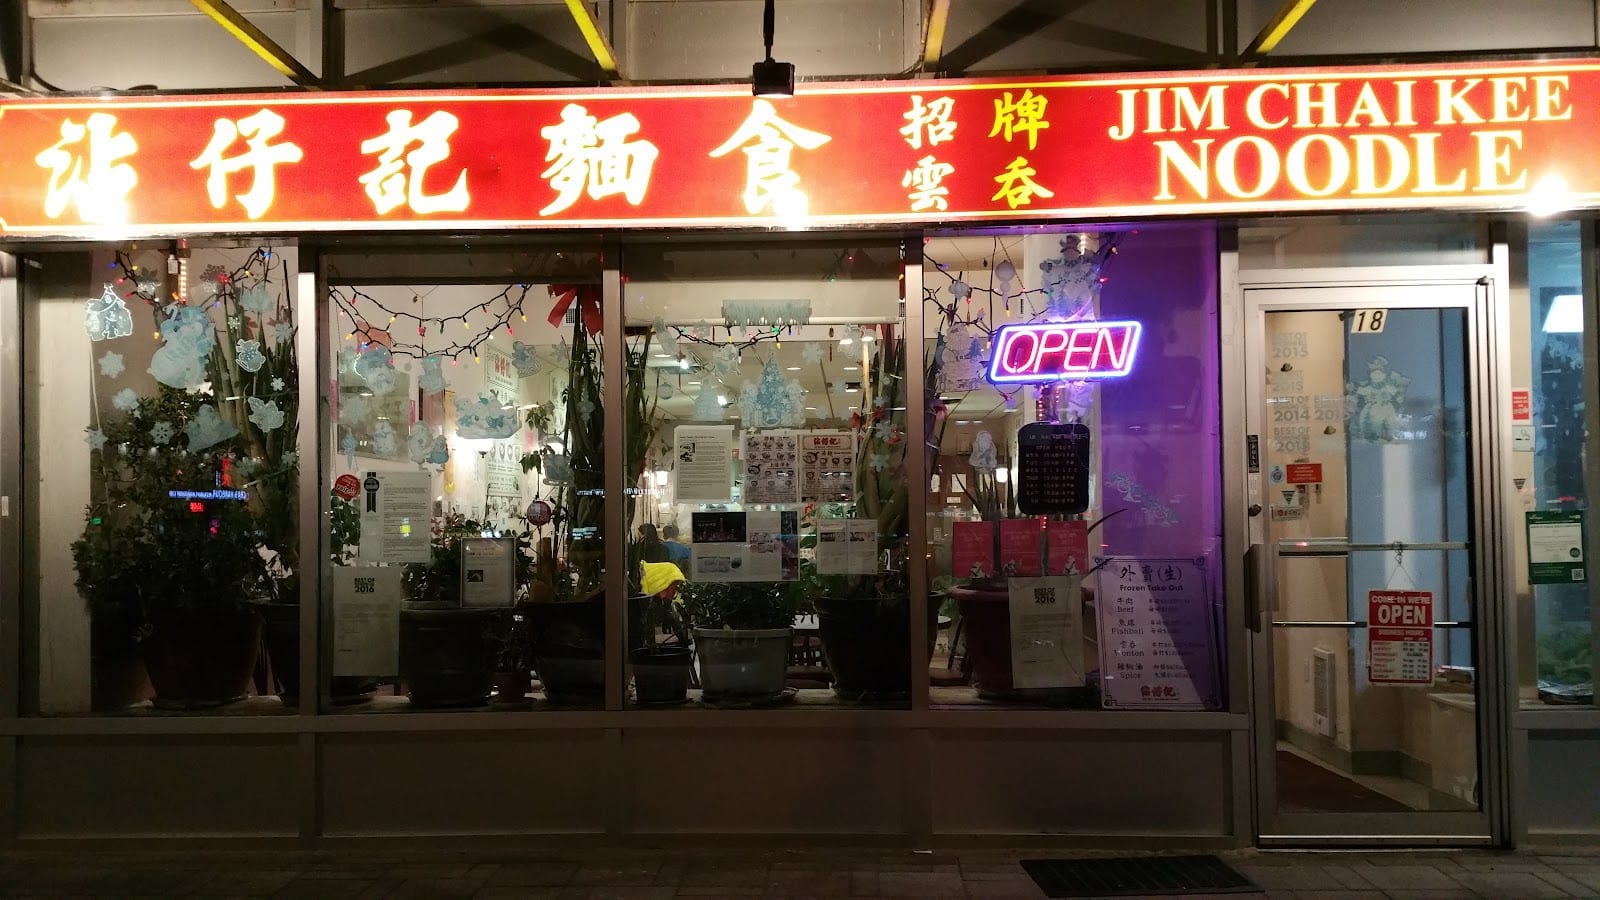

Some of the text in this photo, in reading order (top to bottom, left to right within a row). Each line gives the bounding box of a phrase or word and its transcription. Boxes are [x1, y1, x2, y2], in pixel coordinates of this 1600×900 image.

[1107, 75, 1573, 141] JIM CHAI KEE
[898, 88, 1051, 151] 招牌
[1153, 129, 1528, 201] NOODLE
[1357, 310, 1384, 332] 18
[1002, 326, 1133, 374] OPEN
[1273, 347, 1310, 358] 2015
[1274, 410, 1311, 421] 2014
[1274, 426, 1311, 435] BEST OF
[1372, 596, 1395, 604] COME
[1378, 605, 1426, 624] OPEN
[1114, 649, 1144, 657] Wonton
[1120, 671, 1142, 680] Spice
